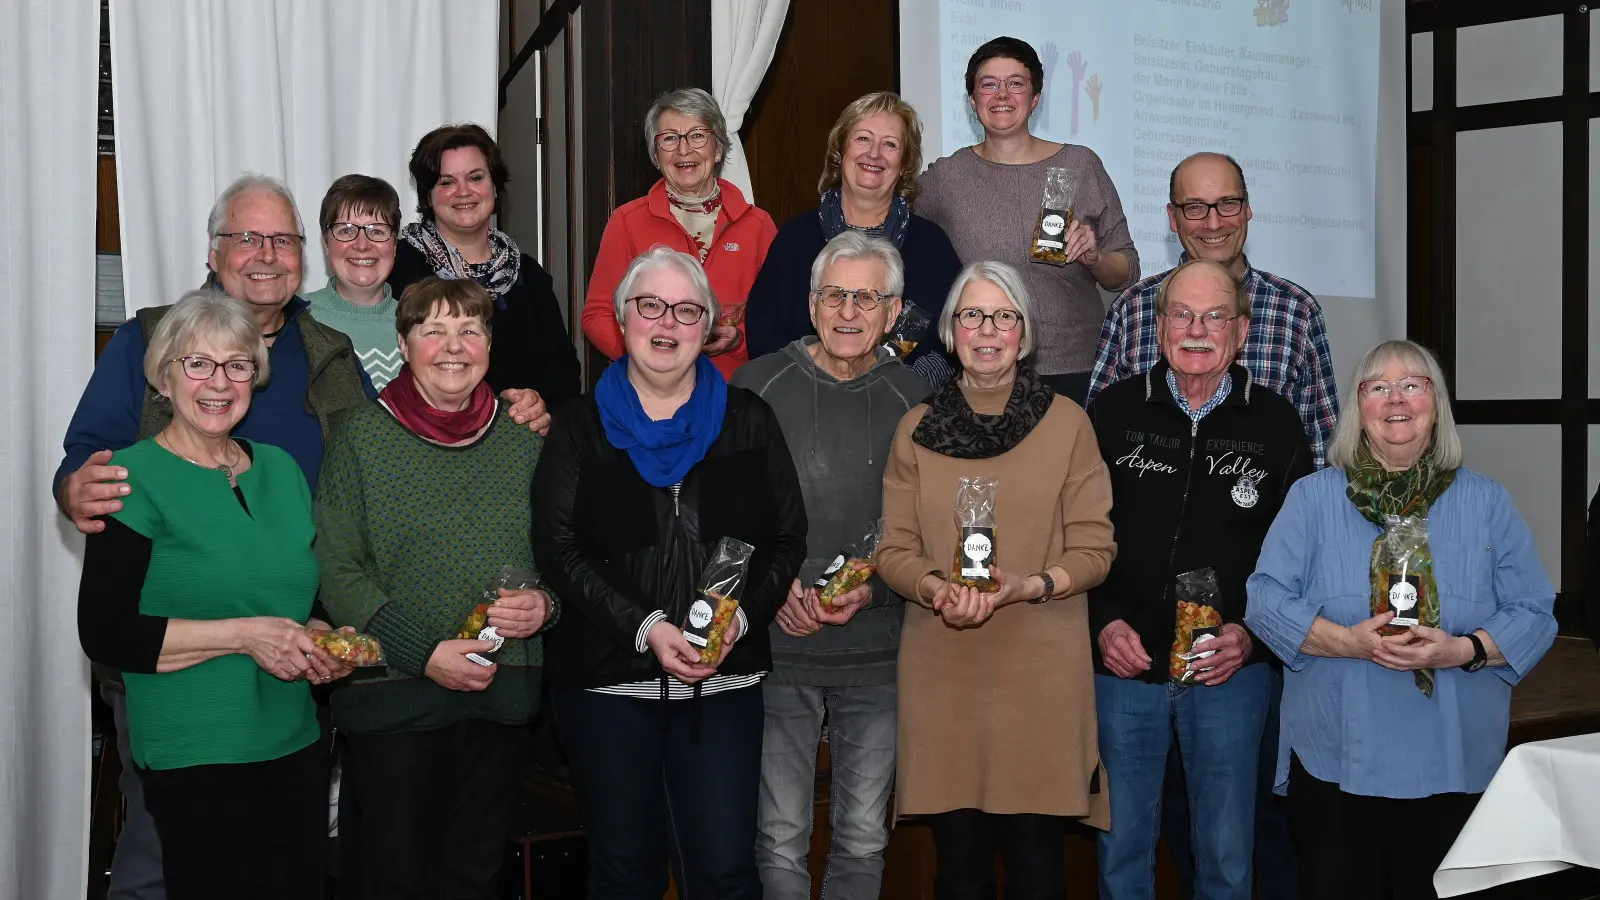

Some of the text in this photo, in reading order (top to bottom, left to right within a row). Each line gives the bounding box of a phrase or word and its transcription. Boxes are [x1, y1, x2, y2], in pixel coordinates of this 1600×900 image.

[1239, 47, 1312, 69] Raummanager
[1194, 59, 1278, 81] Geburtstagsfrau
[1133, 71, 1150, 84] der
[1153, 73, 1182, 89] Mann
[1185, 76, 1200, 90] für
[1203, 78, 1222, 93] alle
[1224, 82, 1248, 96] Fälle
[1133, 90, 1196, 108] Organisator
[1198, 97, 1211, 111] im
[1214, 100, 1274, 118] Hintergrund
[1289, 106, 1340, 125] (Leinwand
[1133, 109, 1229, 130] Anwesenheitsliste
[1133, 127, 1227, 148] Geburtstagsmann
[1284, 160, 1351, 178] Organisatorin
[1045, 221, 1063, 229] DANKE
[1140, 259, 1167, 272] arald
[1125, 430, 1181, 450] TOM TAILOR
[1206, 438, 1265, 456] EXPERIENCE
[1115, 444, 1178, 478] Aspen
[1205, 451, 1269, 485] Valley
[1235, 487, 1255, 496] ASPEN
[967, 543, 988, 552] DANKE
[691, 607, 710, 621] DANKE
